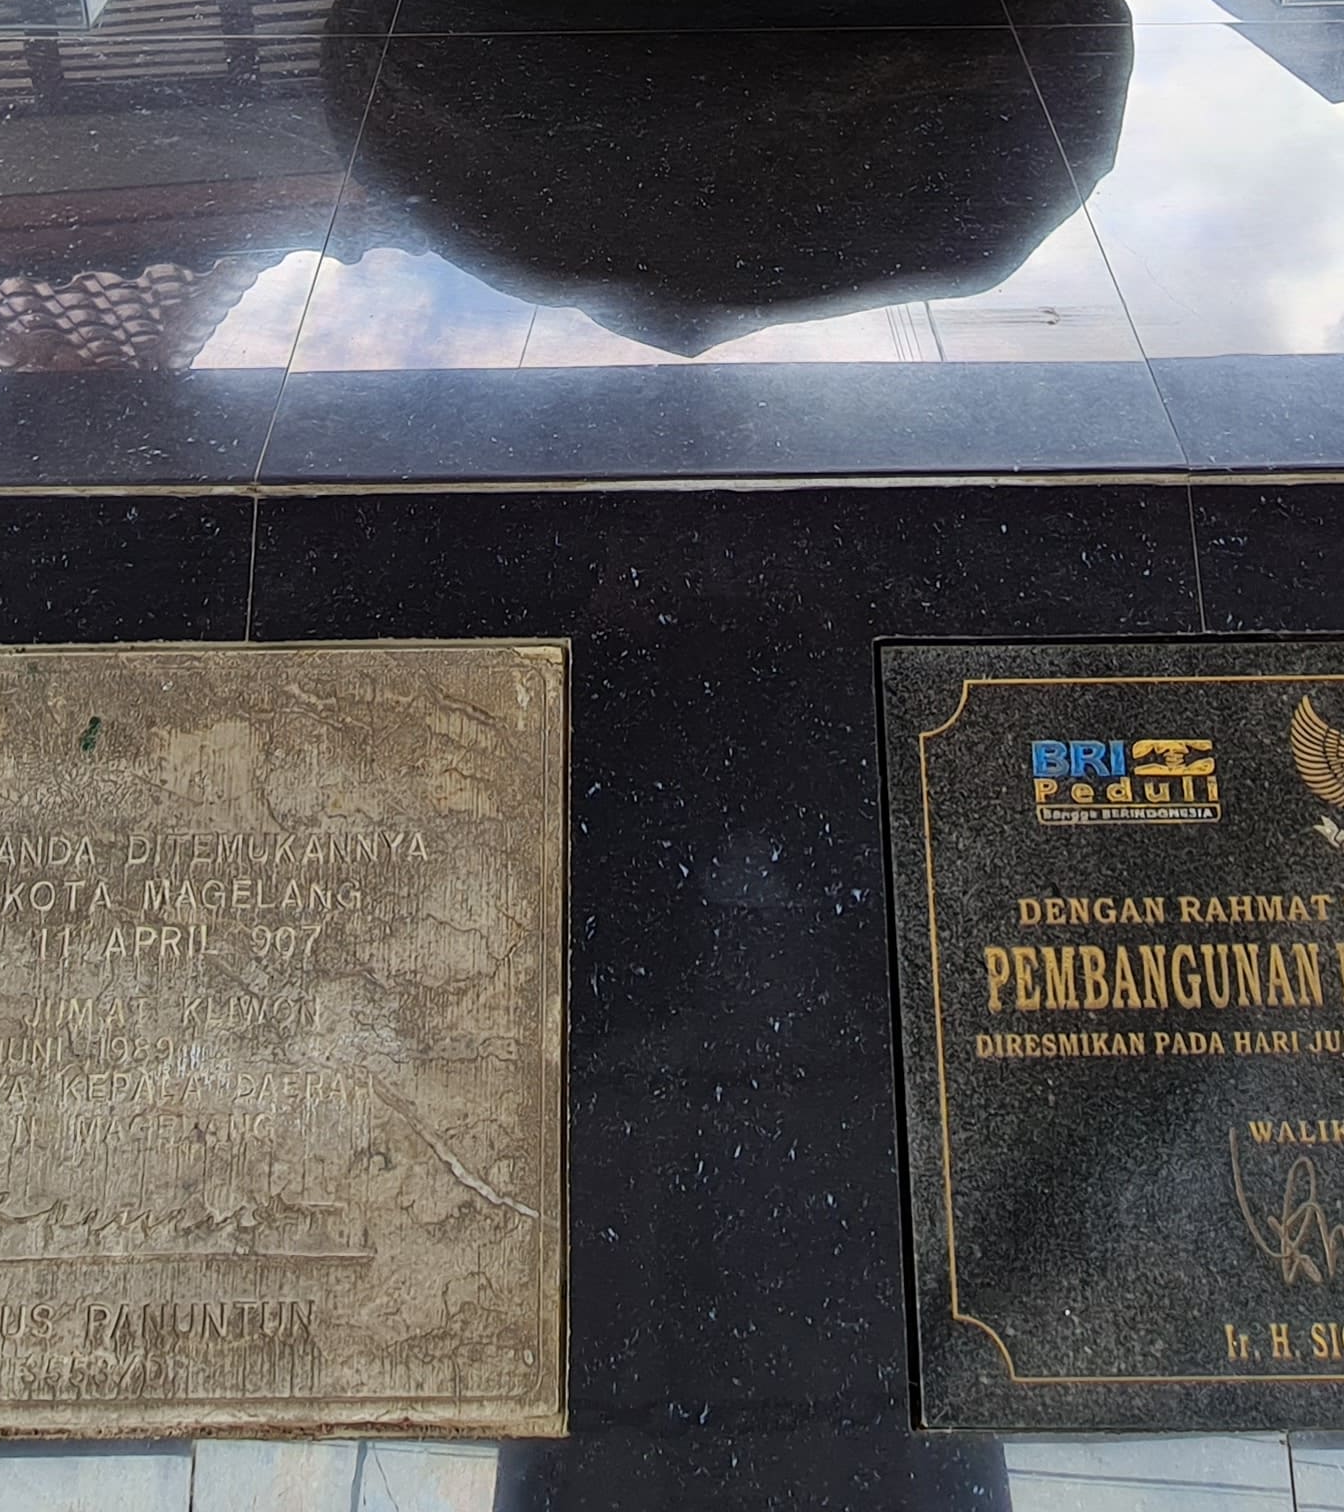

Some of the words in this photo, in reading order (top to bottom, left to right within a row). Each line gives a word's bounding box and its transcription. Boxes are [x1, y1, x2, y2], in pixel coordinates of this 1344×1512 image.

[1032, 739, 1126, 777] BRI
[1034, 776, 1219, 804] Peduli
[1101, 806, 1214, 821] BERINDONESIA
[126, 832, 430, 866] DITEMUKANNYA
[2, 880, 112, 913] KOTA
[142, 878, 361, 912] MAGELANG
[1018, 895, 1165, 926] DENGAN
[1179, 894, 1332, 925] RAHMAT
[105, 924, 219, 959] APRIL
[250, 924, 323, 958] 907
[984, 942, 1325, 1013] PEMBANGUNAN
[97, 1035, 175, 1066] 1989
[976, 1031, 1146, 1058] DIRESMIKAN
[1155, 1031, 1225, 1056] PADA
[1234, 1030, 1300, 1055] HARI
[1269, 1322, 1301, 1359] H.
